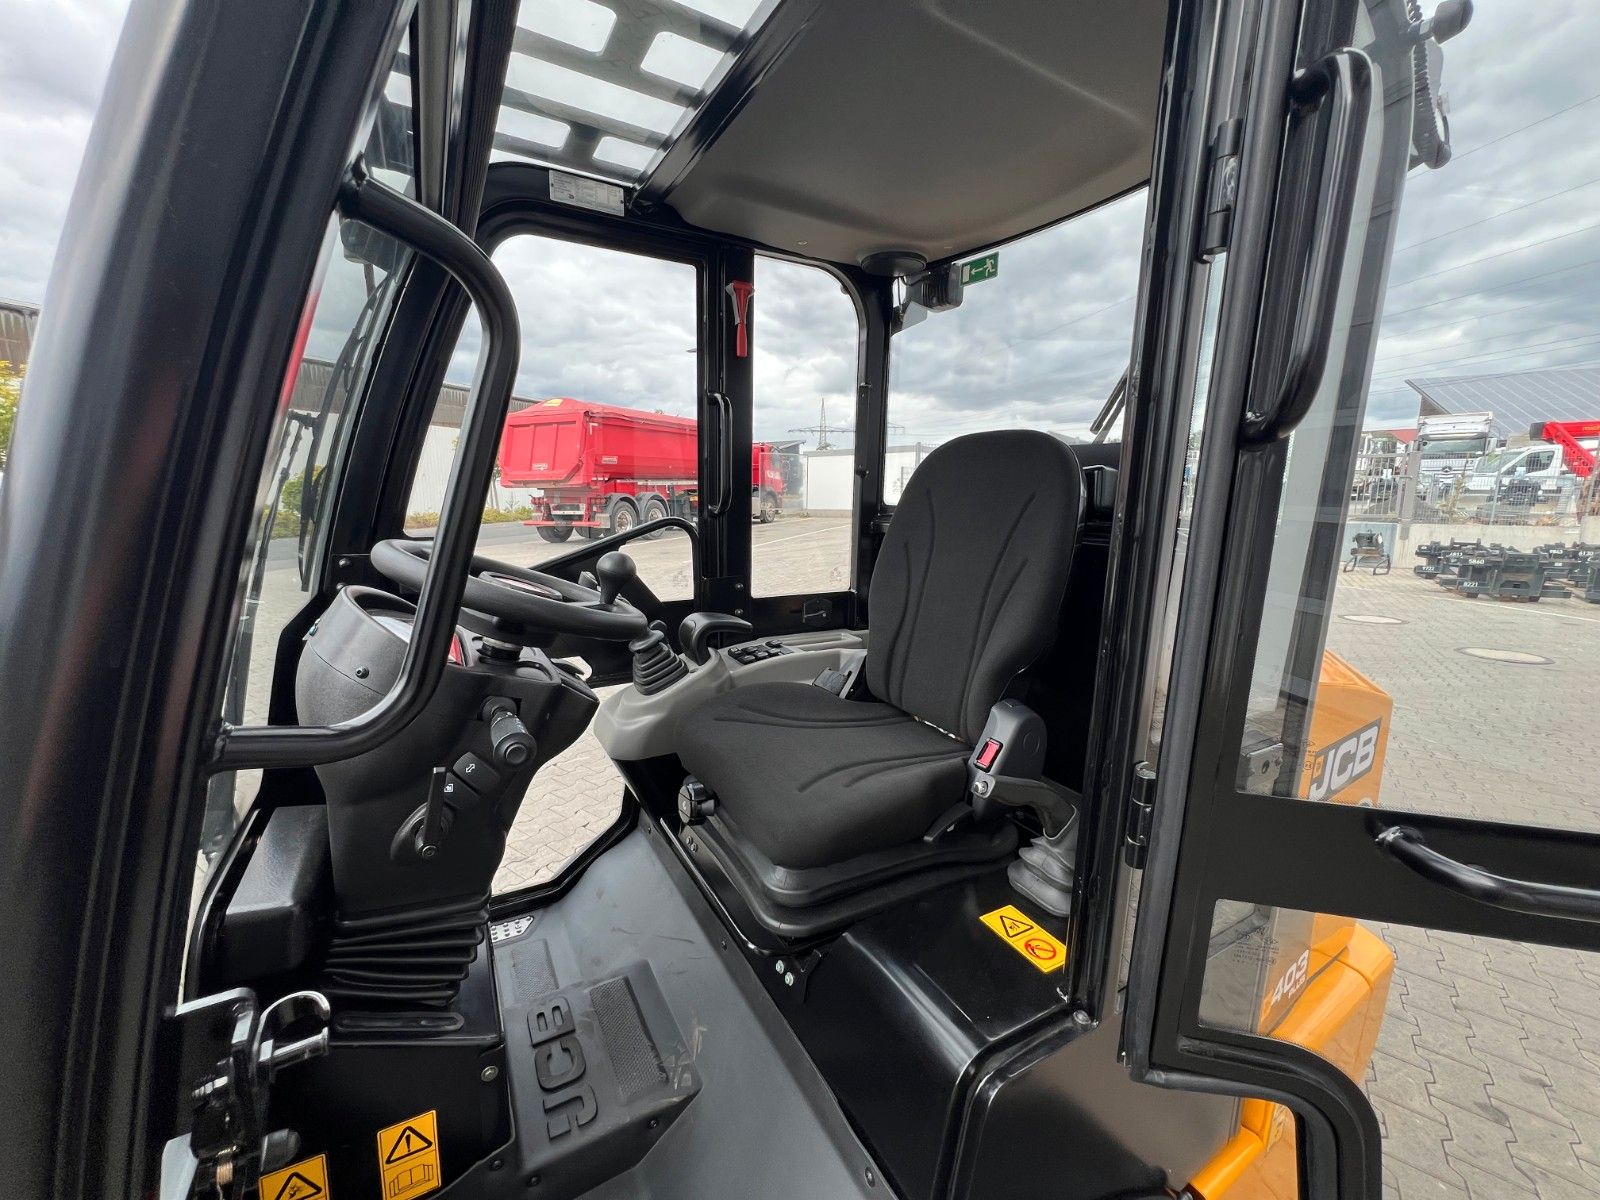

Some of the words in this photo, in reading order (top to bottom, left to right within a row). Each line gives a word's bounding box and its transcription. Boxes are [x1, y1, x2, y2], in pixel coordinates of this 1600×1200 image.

[1308, 726, 1379, 801] JCB
[1269, 949, 1310, 1007] 403
[1288, 973, 1306, 999] PLUS
[526, 995, 599, 1141] JCB
